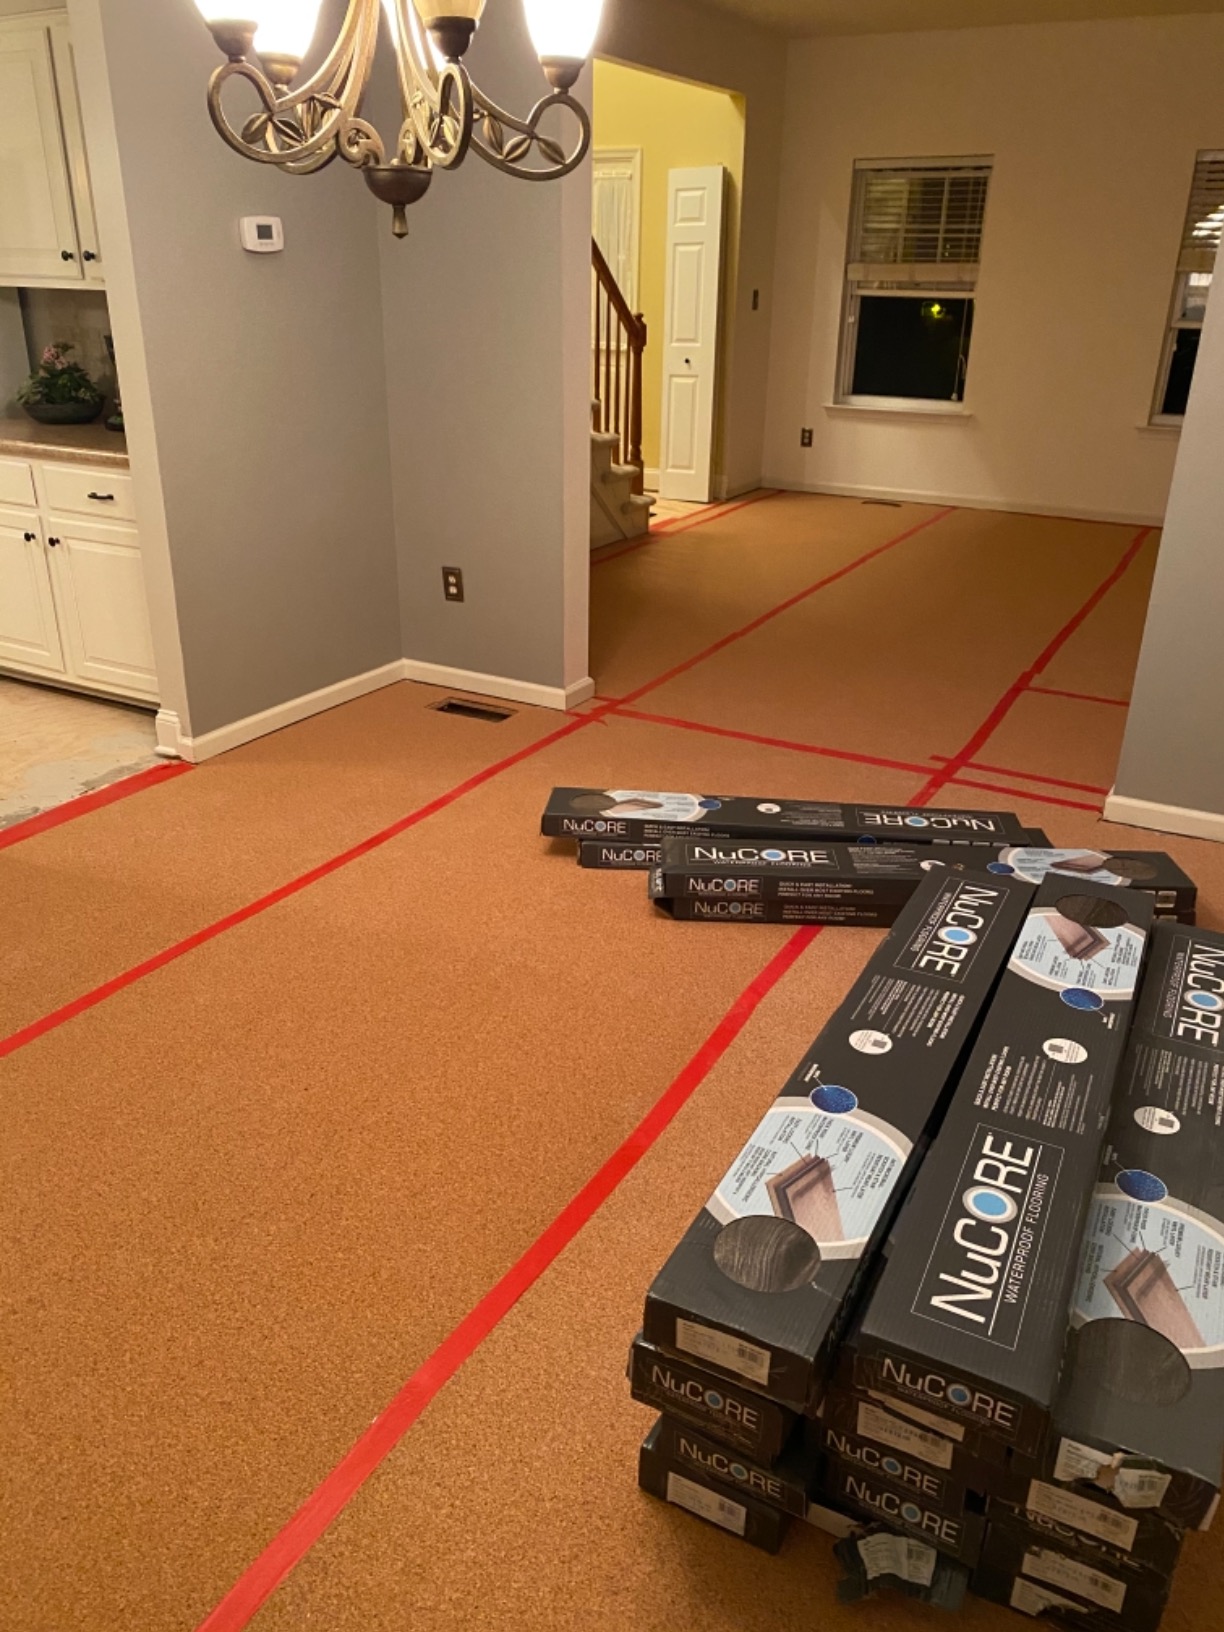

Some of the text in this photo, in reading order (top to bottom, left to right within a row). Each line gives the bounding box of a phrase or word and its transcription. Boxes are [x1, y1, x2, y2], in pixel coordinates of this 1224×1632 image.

[563, 819, 627, 834] NuCORE
[694, 847, 830, 863] NuCORE
[689, 878, 760, 893] NuCORE
[694, 901, 765, 914] NuCORE
[918, 885, 999, 977] NuCORE
[1177, 943, 1224, 1047] NuCORE
[930, 1134, 1035, 1324] NuCORE
[1004, 1173, 1050, 1304] WATERPROOF FLOORING
[652, 1365, 761, 1430] NuCORE
[882, 1358, 1016, 1427] NuCORE
[679, 1438, 783, 1499] NuCORE
[826, 1429, 941, 1498] NuCORE
[846, 1475, 960, 1544] NuCORE
